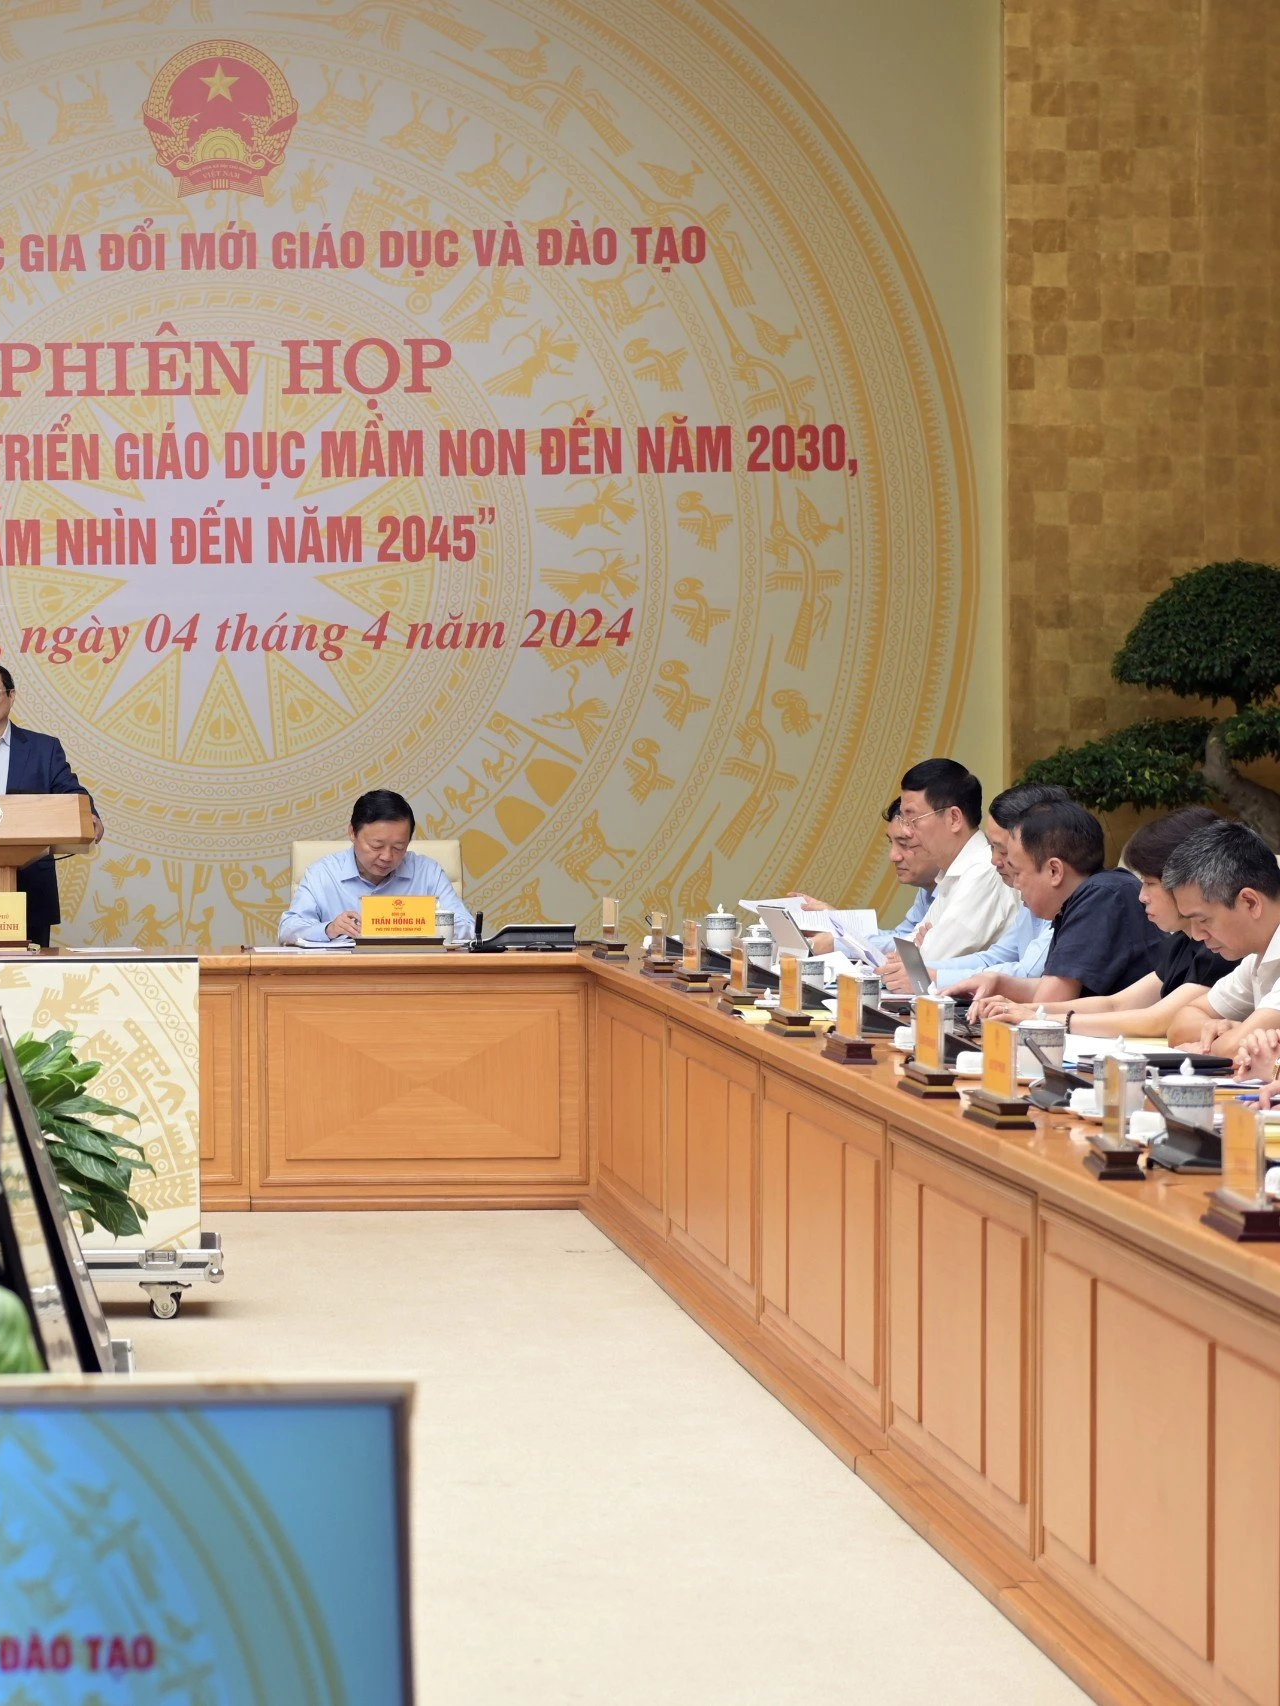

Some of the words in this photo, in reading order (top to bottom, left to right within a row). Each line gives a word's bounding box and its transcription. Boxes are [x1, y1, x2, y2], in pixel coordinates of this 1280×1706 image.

[20, 234, 86, 272] GIA
[98, 218, 166, 271] ĐỔI
[181, 220, 257, 270] MỚI
[272, 223, 365, 269] GIÁO
[380, 229, 459, 276] DỤC
[473, 220, 525, 267] VÀ
[537, 219, 618, 266] ĐÀO
[631, 225, 707, 273] TẠO
[282, 336, 453, 411] HỌP
[115, 421, 210, 481] GIÁO
[225, 430, 306, 490] DỤC
[321, 413, 424, 478] MẦM
[439, 428, 527, 477] NON
[539, 409, 623, 475] ĐẾN
[637, 415, 733, 474] NĂM
[746, 423, 859, 478] 2030,
[56, 507, 157, 566] NHÌN
[170, 498, 253, 565] ĐẾN
[268, 505, 363, 564] NĂM
[20, 615, 130, 664] ngày
[145, 613, 200, 653] 04
[215, 612, 348, 662] tháng
[362, 611, 390, 650] 4
[405, 612, 505, 650] năm
[521, 607, 634, 649] 2024
[88, 1636, 156, 1680] TẠO
